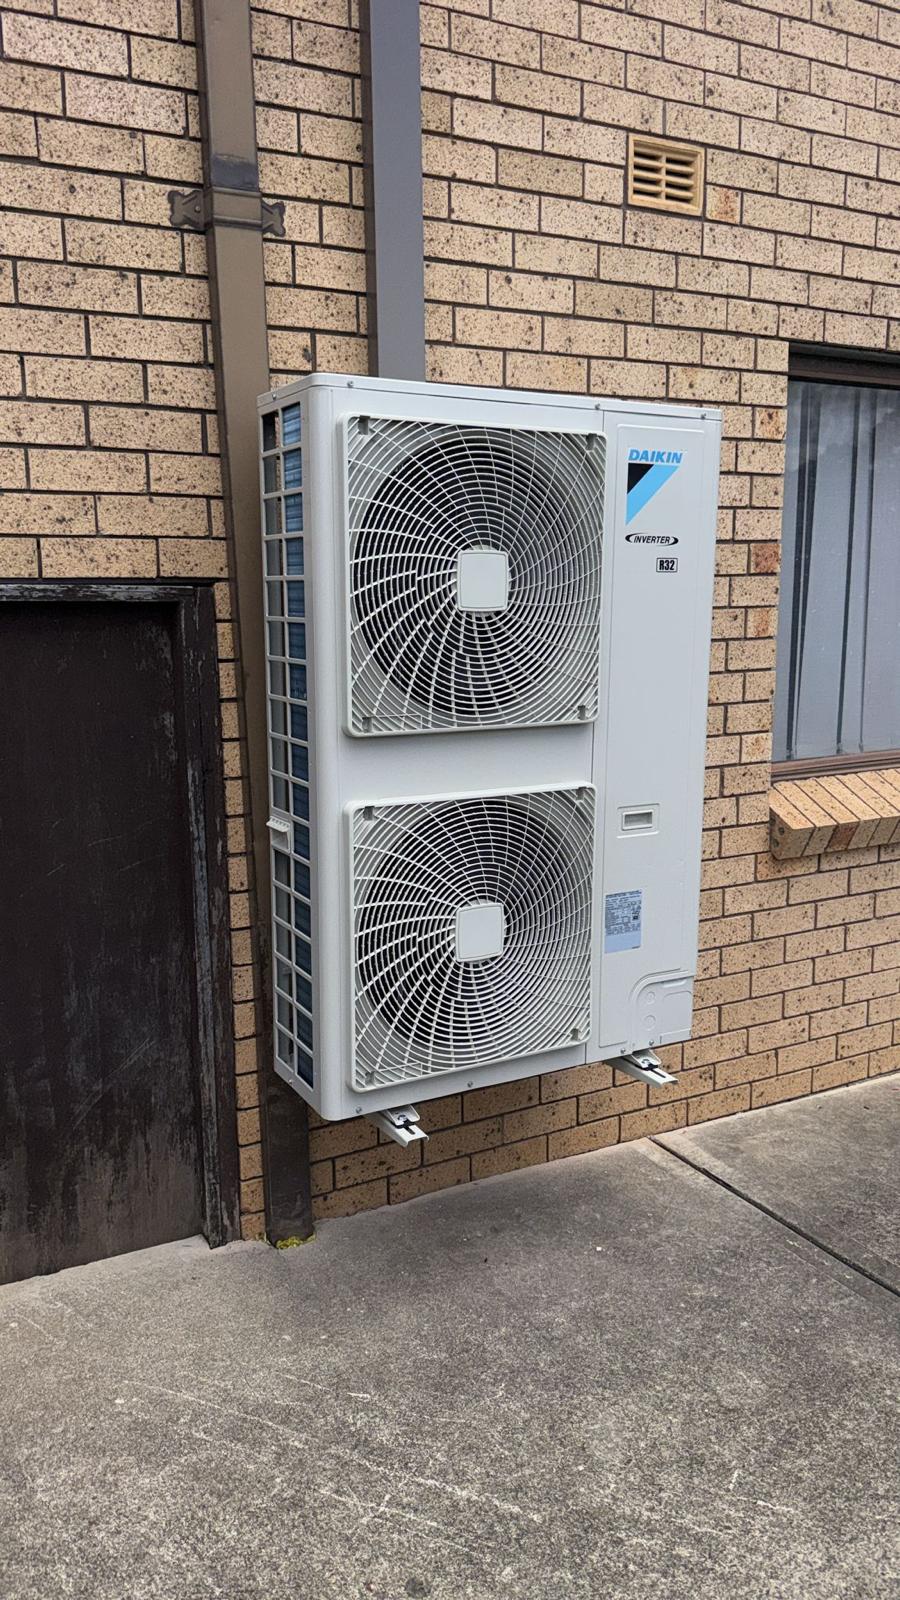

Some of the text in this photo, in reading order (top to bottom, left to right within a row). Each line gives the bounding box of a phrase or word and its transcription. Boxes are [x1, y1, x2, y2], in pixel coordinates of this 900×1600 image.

[628, 449, 683, 464] DAIKIN
[633, 535, 671, 544] INVERTER
[659, 559, 675, 571] R32
